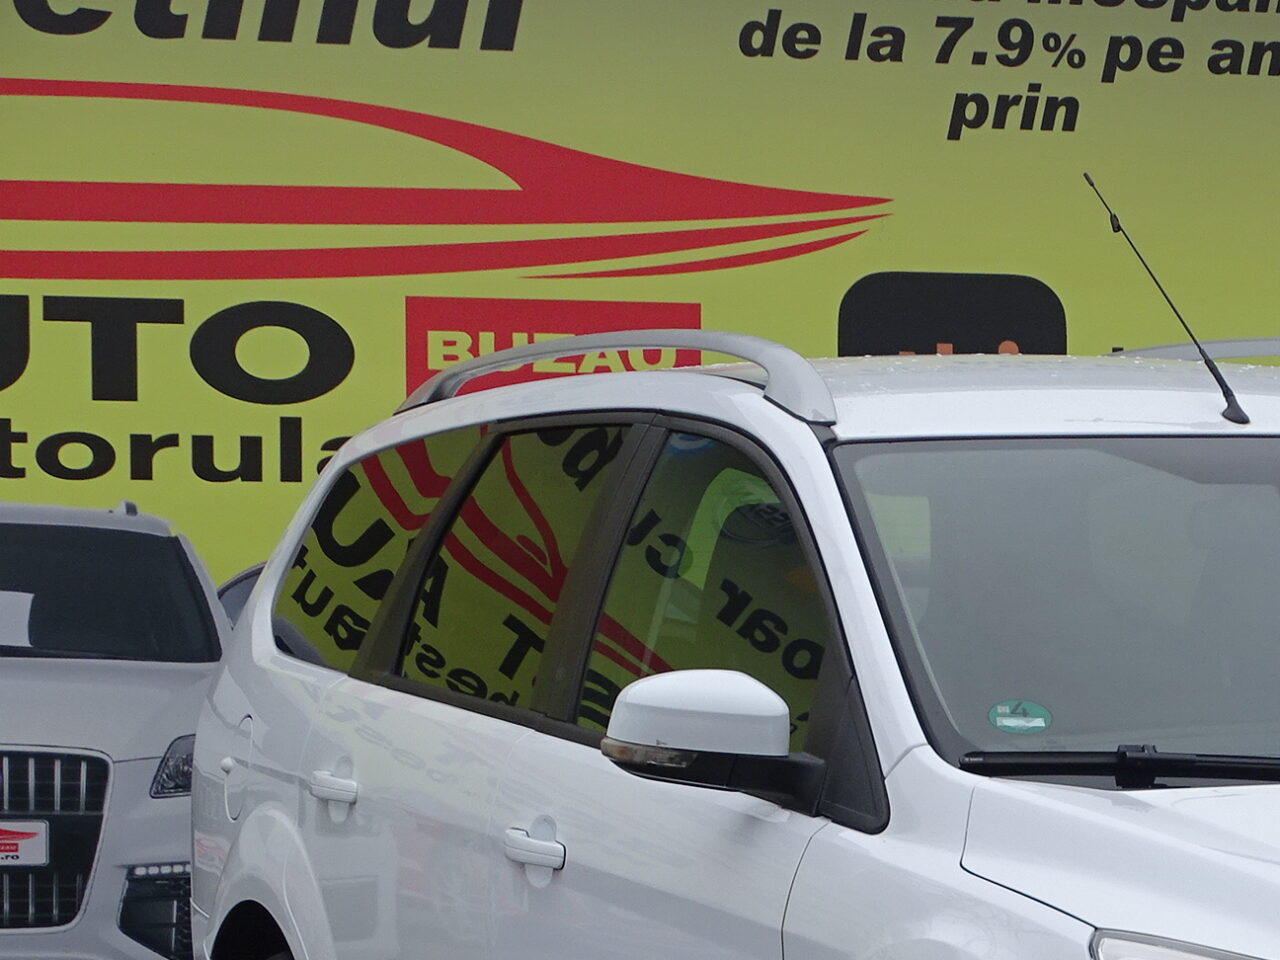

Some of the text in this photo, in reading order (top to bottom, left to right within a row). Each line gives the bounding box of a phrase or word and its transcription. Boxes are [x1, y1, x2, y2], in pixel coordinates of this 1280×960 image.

[738, 9, 822, 59] de
[845, 12, 906, 63] la
[934, 15, 1086, 70] 7.9%
[1101, 34, 1185, 83] pe
[946, 82, 1080, 140] prin
[0, 294, 356, 405] TO
